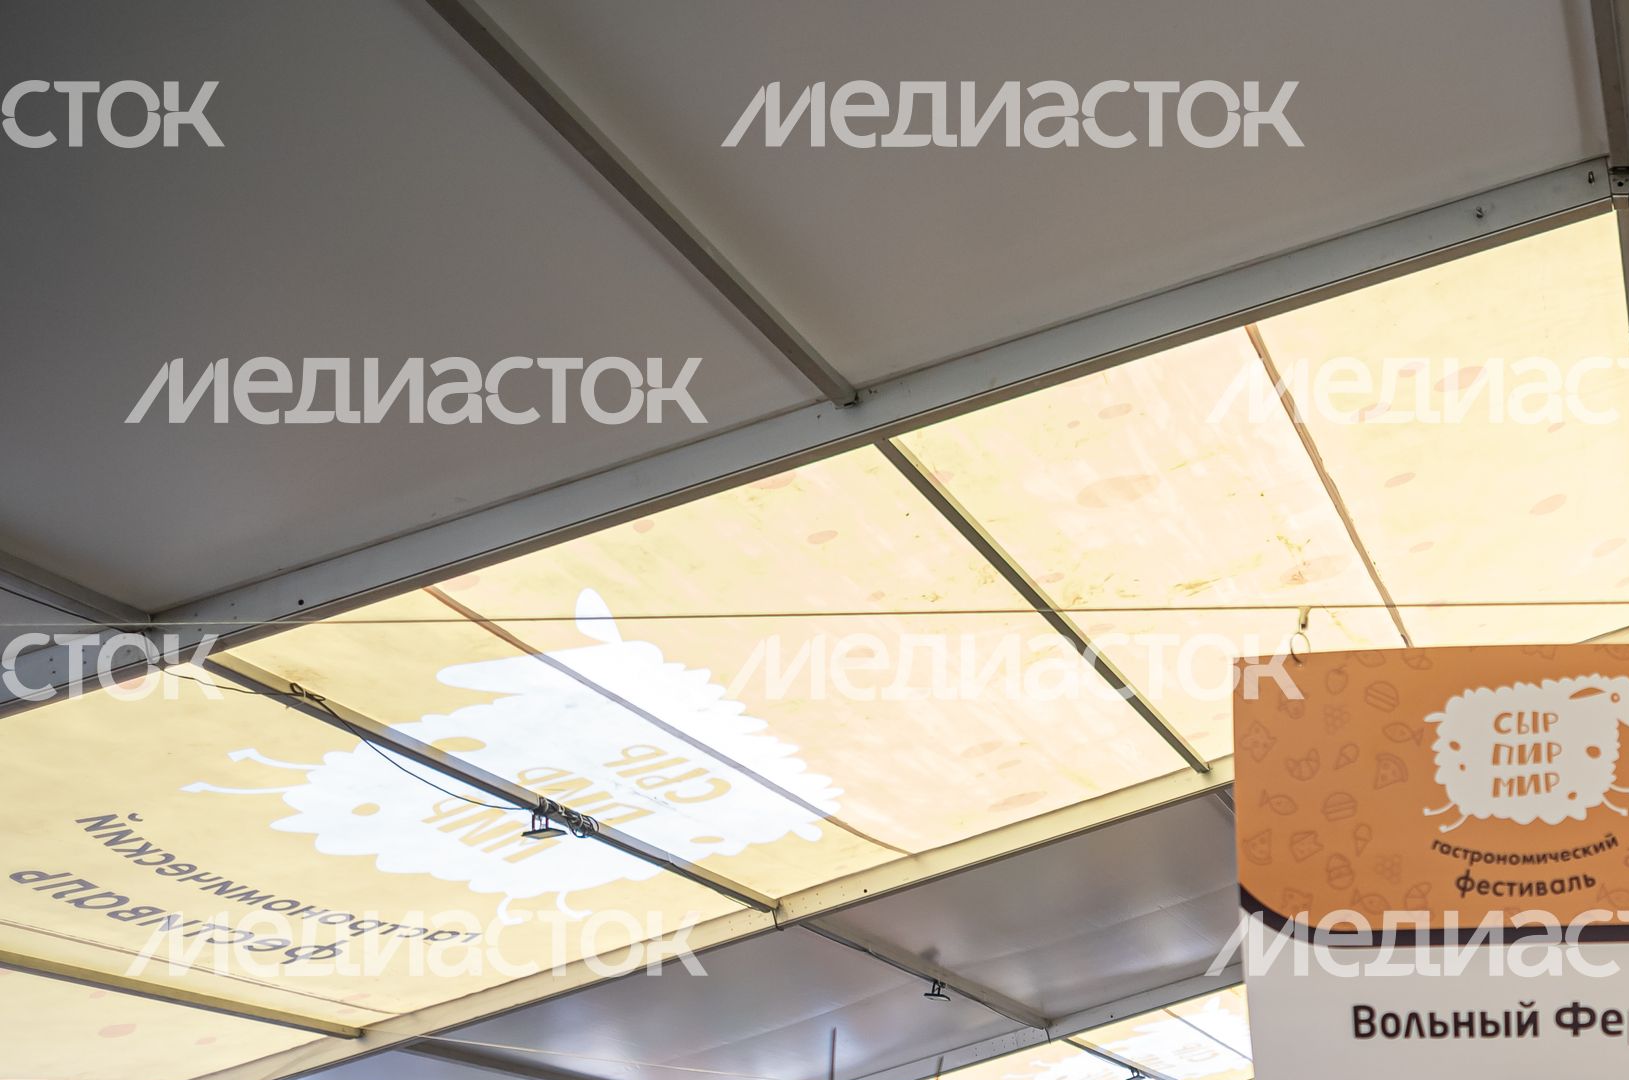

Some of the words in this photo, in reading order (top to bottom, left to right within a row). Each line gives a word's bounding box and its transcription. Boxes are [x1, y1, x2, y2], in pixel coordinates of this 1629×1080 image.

[1493, 711, 1559, 734] СЫР
[1491, 742, 1562, 766] ПИР
[1492, 772, 1560, 797] МИР
[1432, 833, 1619, 866] гастрономический
[1455, 869, 1596, 898] фестиваль
[1352, 1001, 1540, 1039] Вольный
